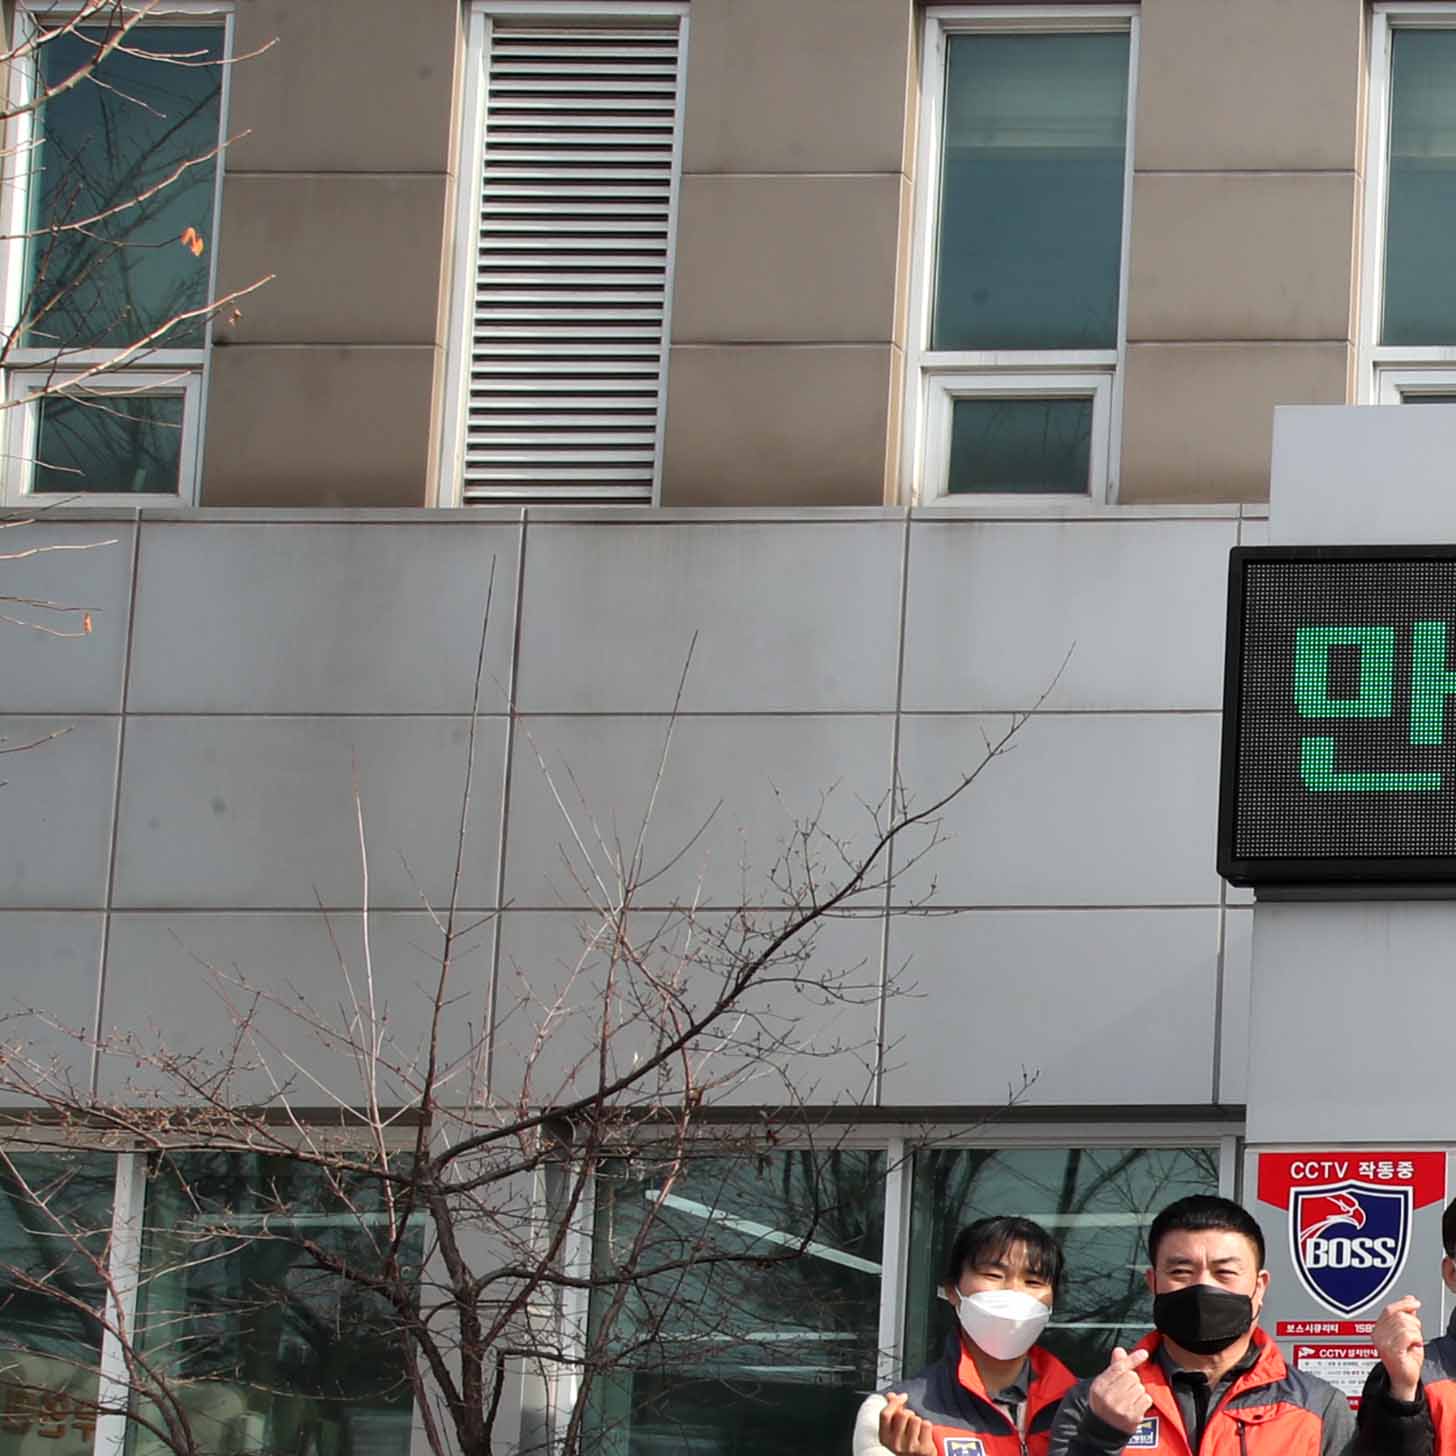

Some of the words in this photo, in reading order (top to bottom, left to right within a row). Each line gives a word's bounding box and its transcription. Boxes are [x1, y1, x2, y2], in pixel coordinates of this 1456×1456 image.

[1290, 1161, 1349, 1179] CCTV
[1359, 1161, 1415, 1179] 작동중
[1306, 1237, 1396, 1269] BOSS
[1319, 1349, 1347, 1358] CCTV
